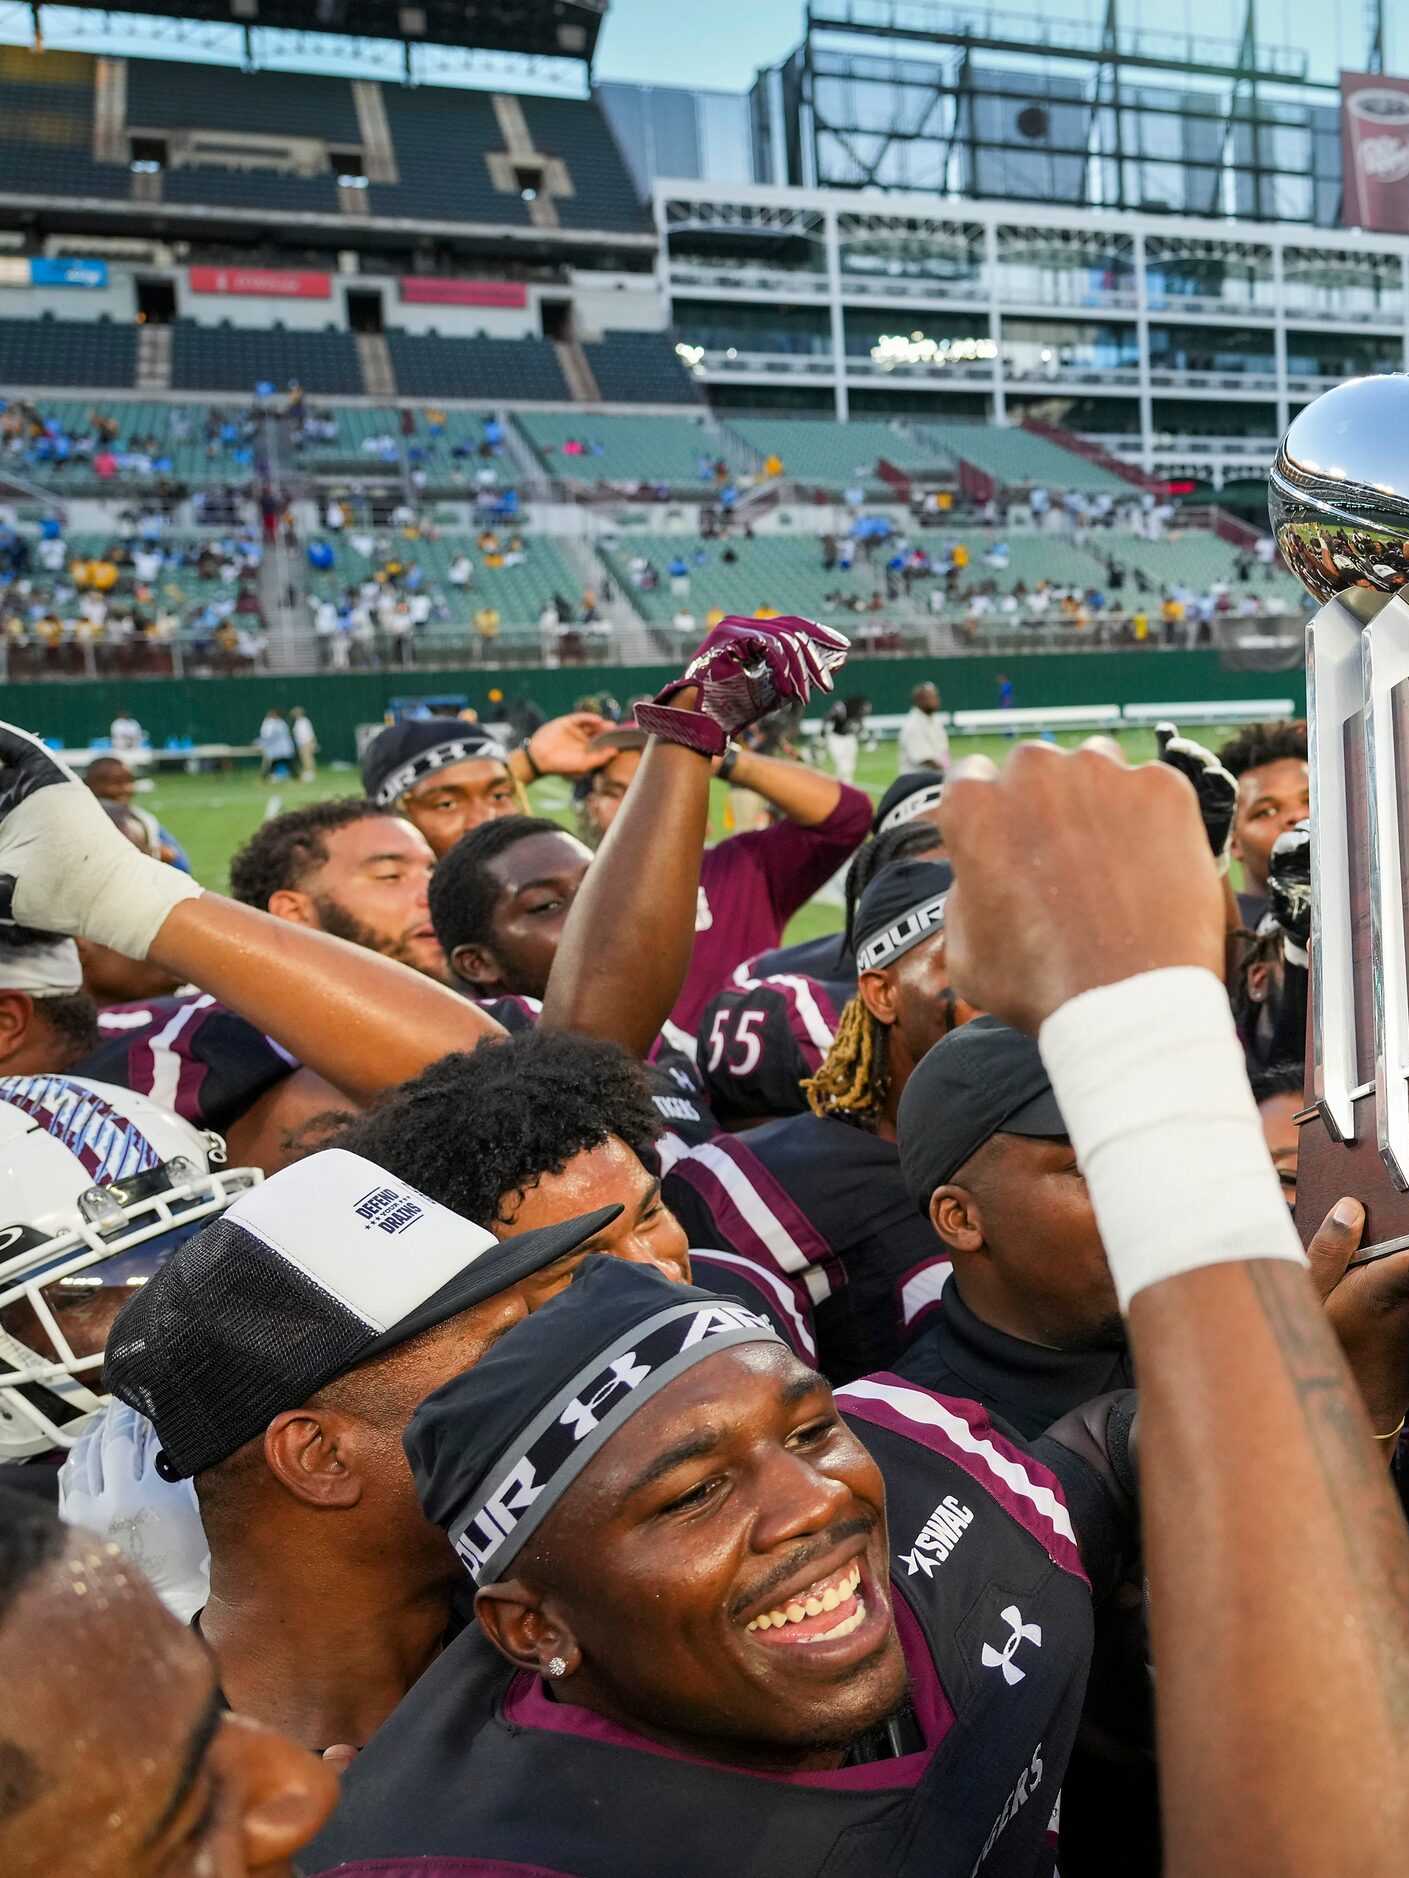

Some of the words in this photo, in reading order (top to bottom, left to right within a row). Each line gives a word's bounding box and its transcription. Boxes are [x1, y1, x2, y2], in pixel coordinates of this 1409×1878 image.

[707, 1009, 765, 1076] 55
[355, 1188, 400, 1220] DEFEND
[378, 1202, 422, 1234] DRAINS
[380, 1201, 400, 1217] YOUR
[914, 1495, 975, 1562] SWAC
